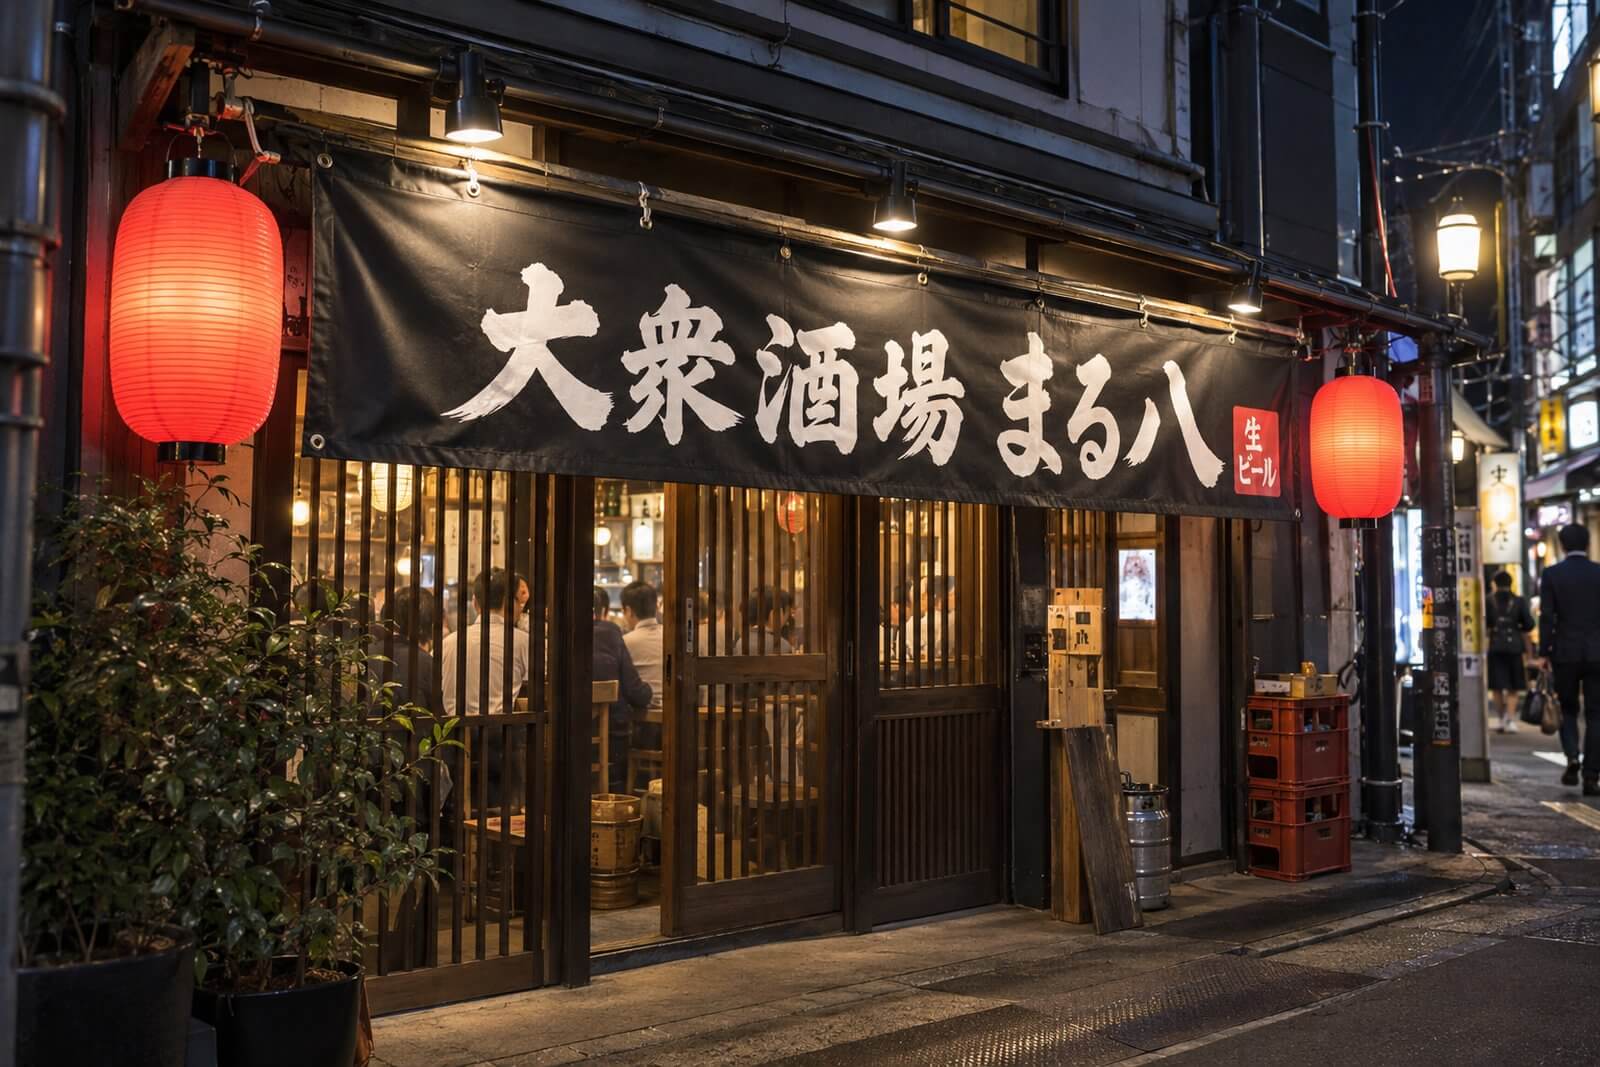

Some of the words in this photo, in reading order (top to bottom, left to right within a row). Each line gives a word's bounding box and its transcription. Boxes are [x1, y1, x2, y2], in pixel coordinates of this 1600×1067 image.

[440, 262, 965, 467] 大衆酒場
[997, 331, 1226, 488] まる八
[1244, 416, 1263, 452] 生
